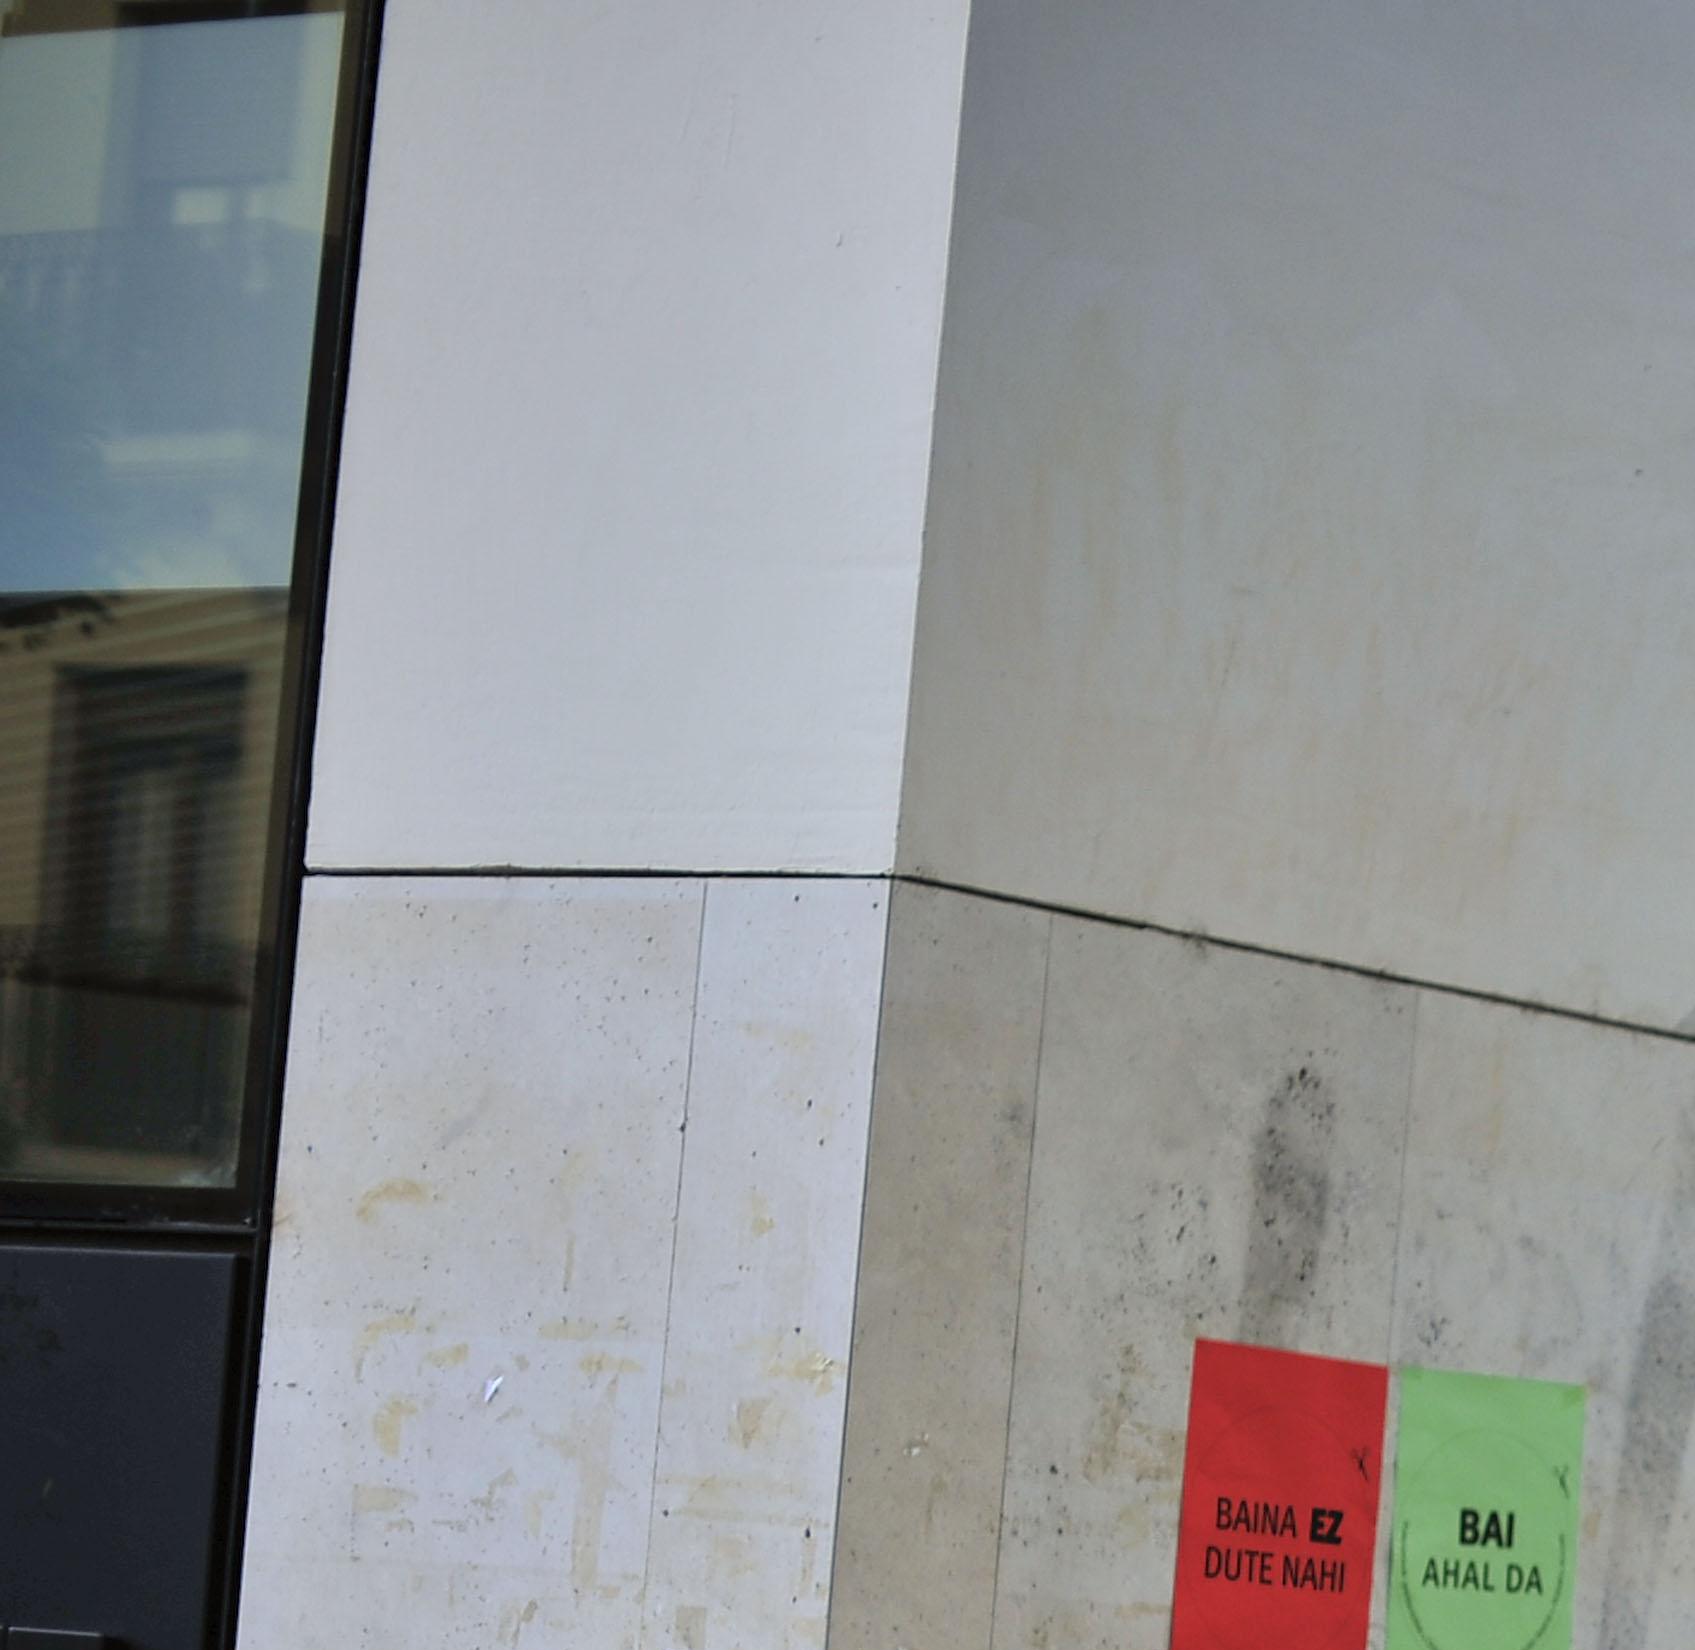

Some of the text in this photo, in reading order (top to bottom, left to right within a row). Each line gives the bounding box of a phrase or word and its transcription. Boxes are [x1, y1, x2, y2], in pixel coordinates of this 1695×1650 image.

[1215, 1496, 1345, 1546] BAINA EZ
[1458, 1507, 1515, 1549] BAI
[1203, 1545, 1346, 1593] DUTE NAHI
[1421, 1557, 1544, 1597] AHAL DA
